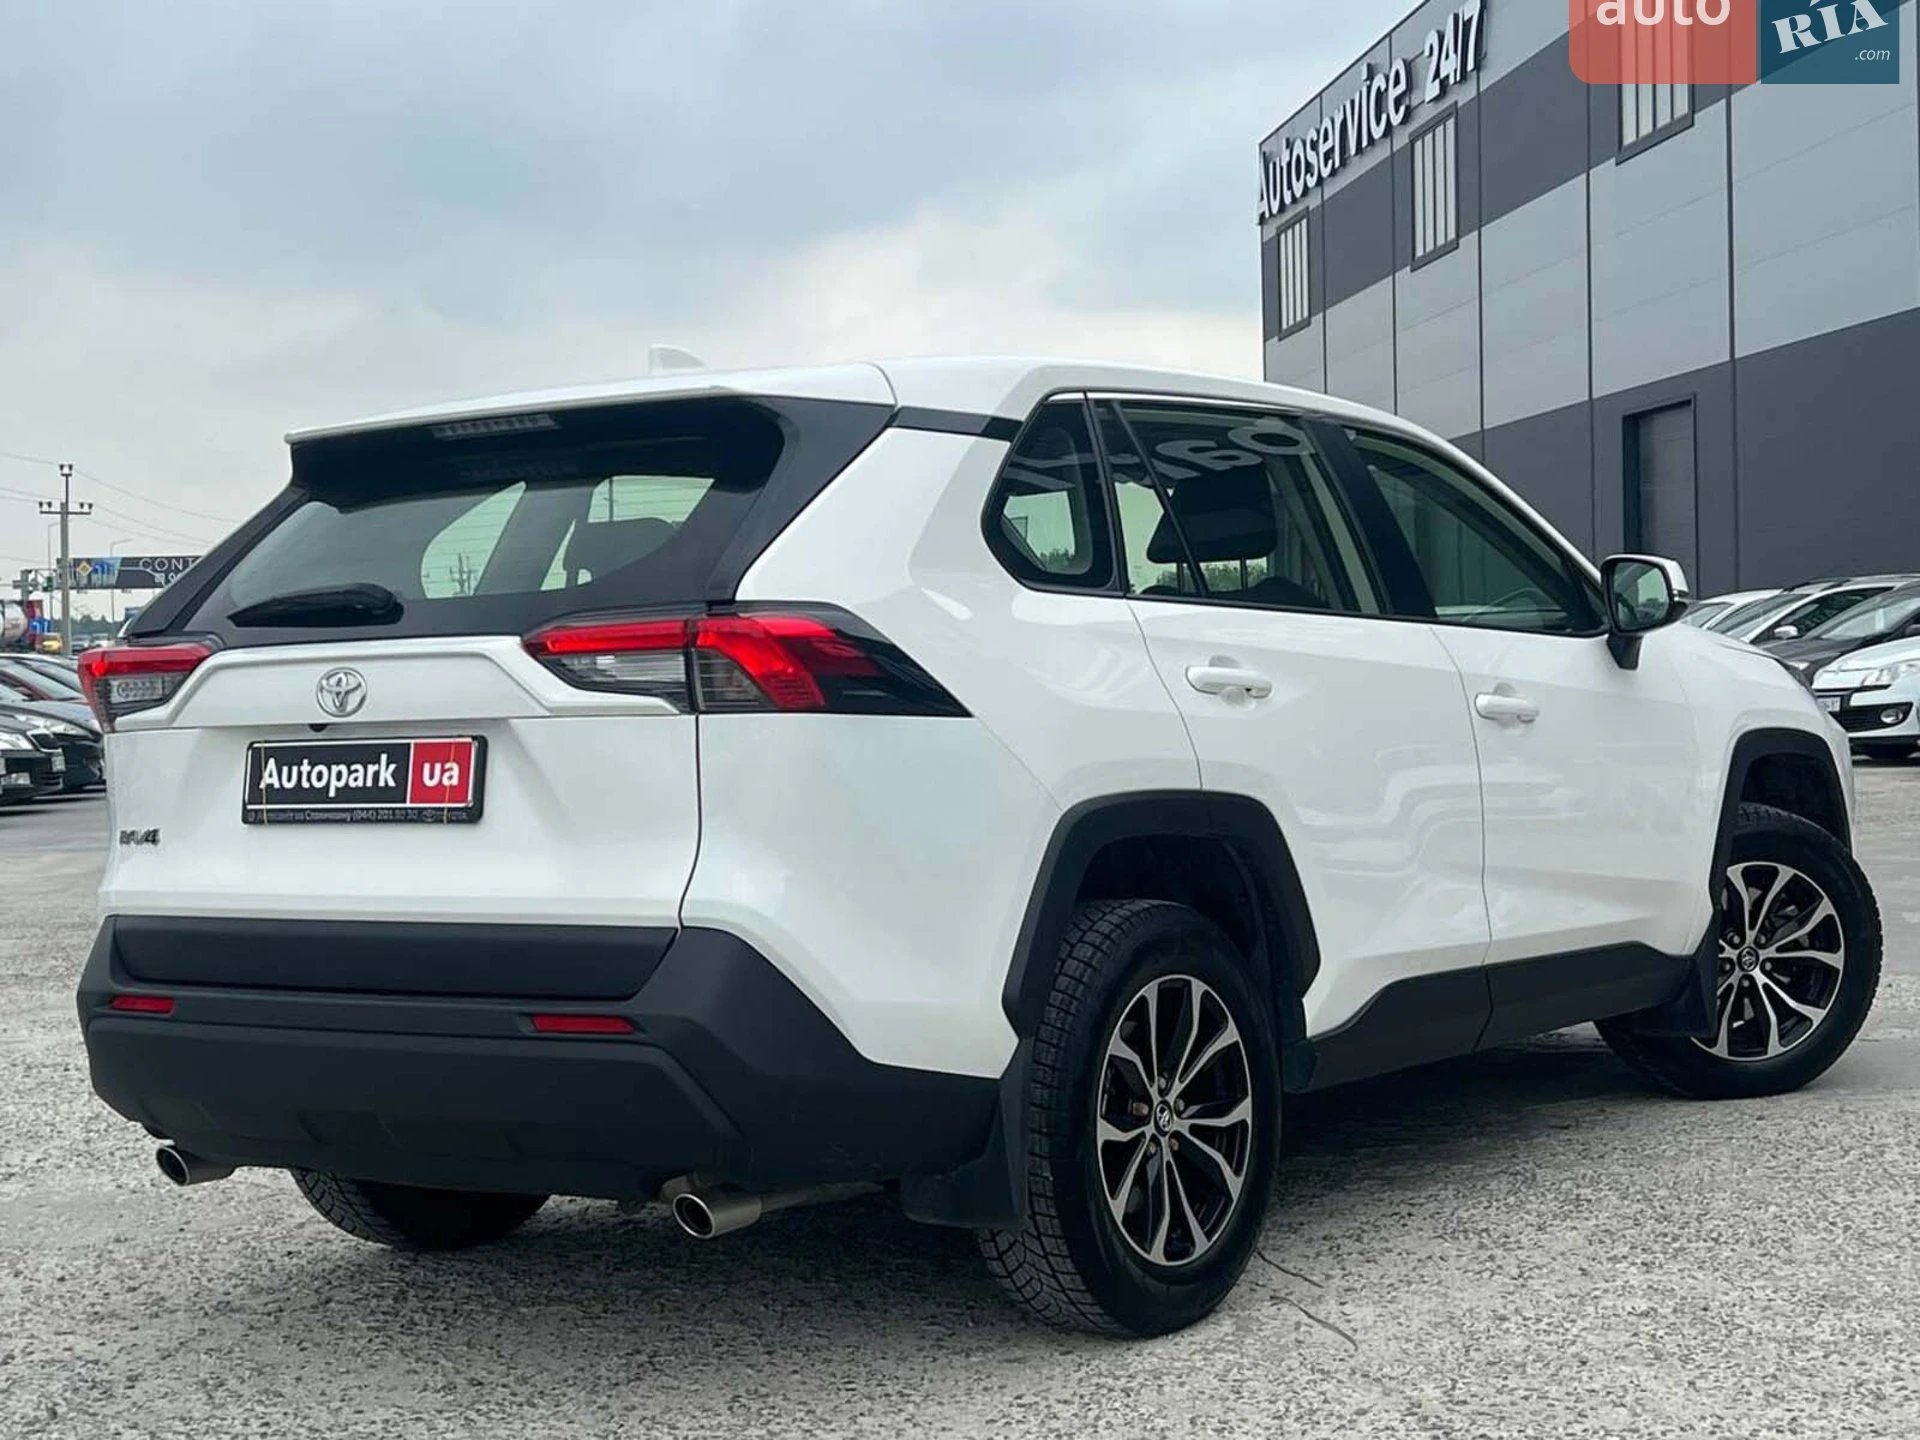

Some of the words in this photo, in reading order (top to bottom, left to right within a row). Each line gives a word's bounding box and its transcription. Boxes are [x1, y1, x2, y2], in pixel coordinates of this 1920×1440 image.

[1258, 58, 1408, 219] Autoservice
[1424, 0, 1482, 103] 24/7
[259, 753, 397, 797] Autopark
[422, 762, 460, 788] ua
